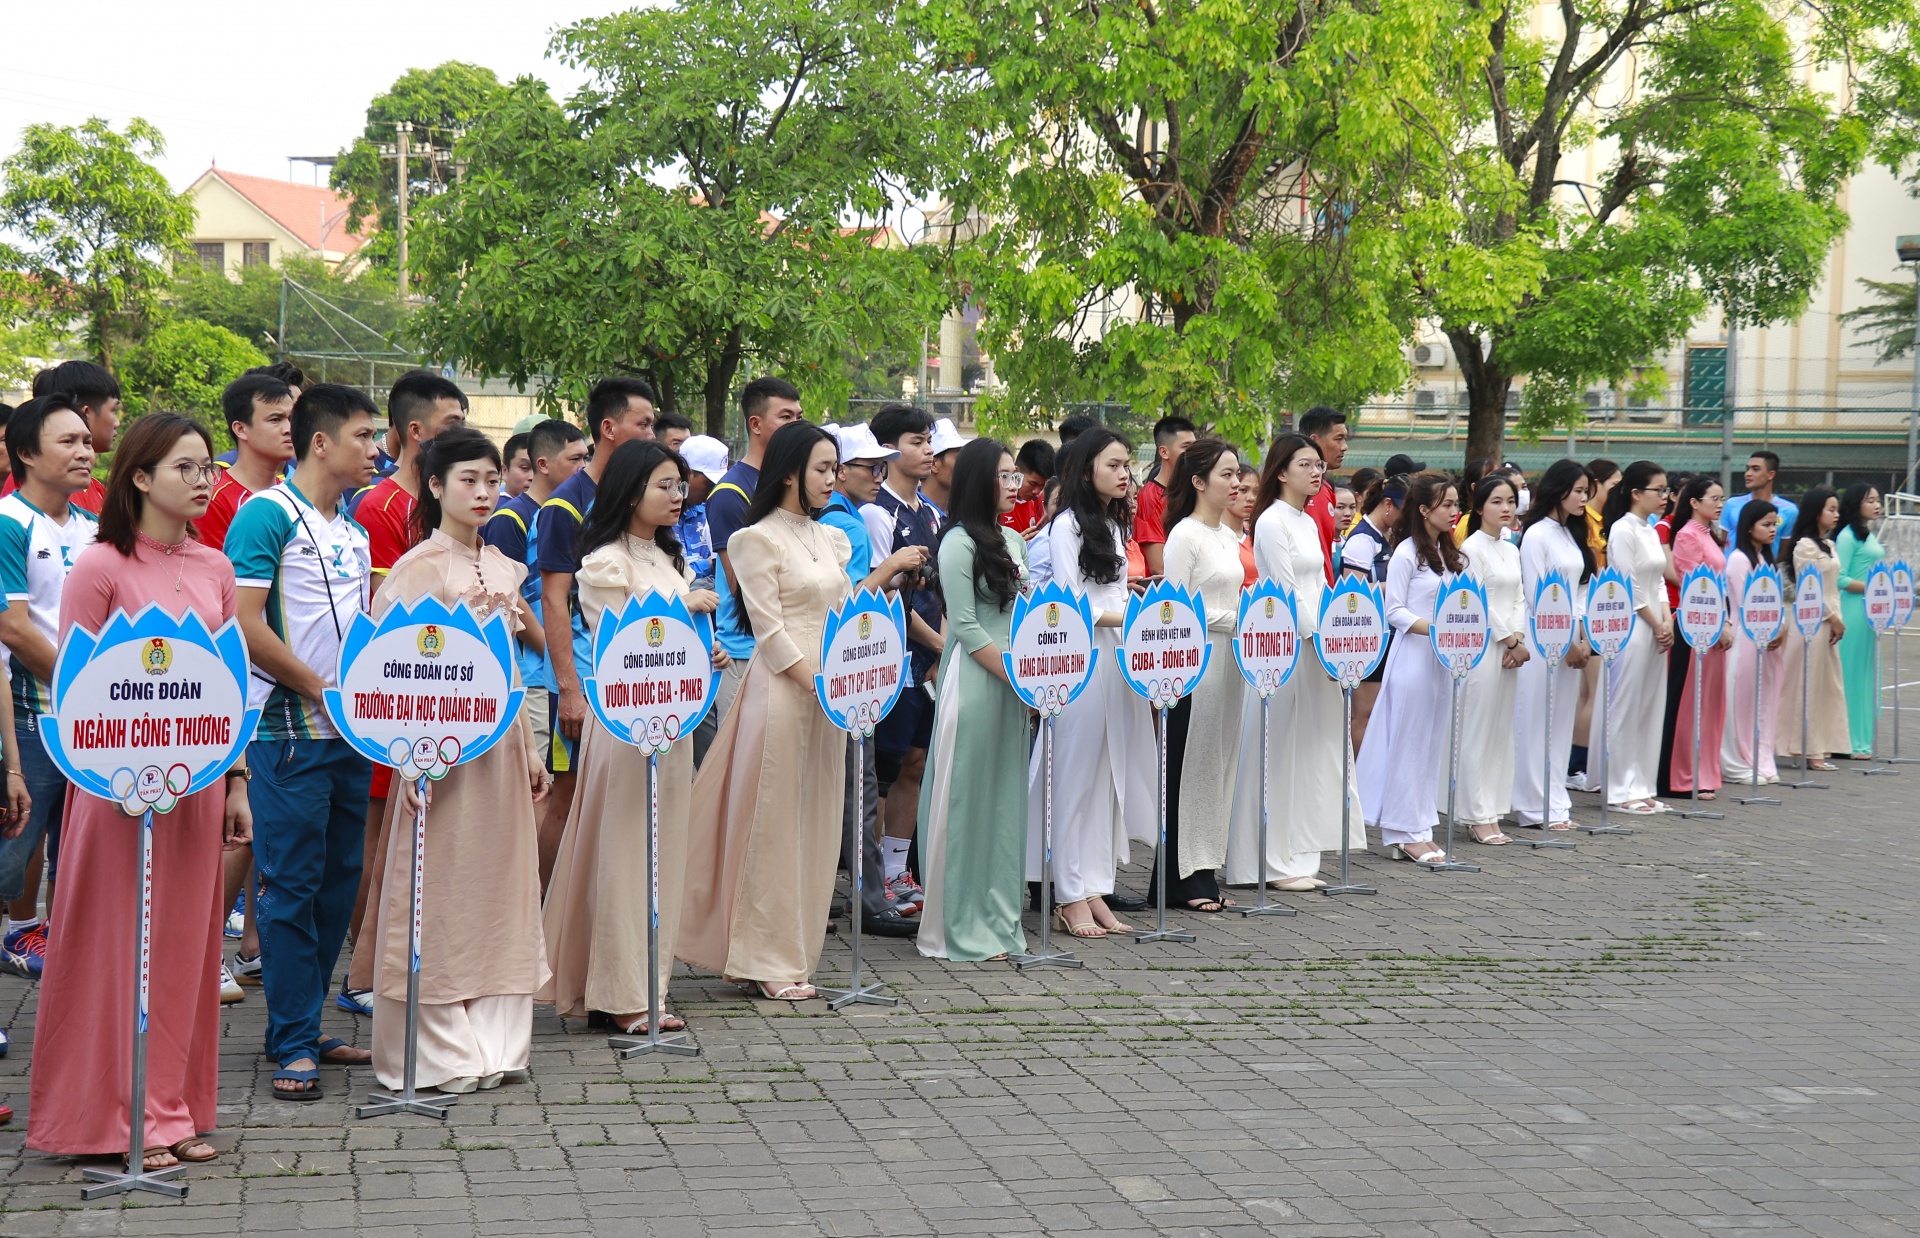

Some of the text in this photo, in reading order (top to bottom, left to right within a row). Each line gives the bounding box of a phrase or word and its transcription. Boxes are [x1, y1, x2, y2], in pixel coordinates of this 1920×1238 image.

[1038, 631, 1067, 645] CÔNG TY
[1141, 626, 1191, 643] BỆNH VIỆN VIỆT NAM
[1243, 622, 1294, 663] TỔ TRỌNG TÀI
[1325, 634, 1342, 654] THÀNH
[1343, 631, 1353, 653] PHỐ
[1355, 631, 1368, 653] ĐỒNG
[623, 647, 686, 669] CÔNG ĐOÀN CƠ SỞ
[843, 637, 887, 663] CÔNG ĐOÀN CƠ SỞ
[1132, 651, 1155, 672] CUBA
[1162, 645, 1184, 669] ĐỒNG
[383, 660, 474, 681] CÔNG ĐOÀN CƠ SỞ
[1019, 649, 1085, 678] XĂNG DẦU QUẢNG BÌNH
[110, 678, 201, 700] CÔNG ĐOÀN
[605, 678, 629, 708] VƯỜN
[632, 674, 656, 709] QUỐC
[658, 681, 672, 705] GIA
[680, 678, 702, 702] PNKB
[830, 664, 897, 700] CÔNG TY CP VIỆT TRUNG
[354, 687, 497, 727] TRƯỜNG ĐẠI HỌC QUẢNG BÌNH
[73, 712, 231, 749] NGÀNH CÔNG THƯƠNG
